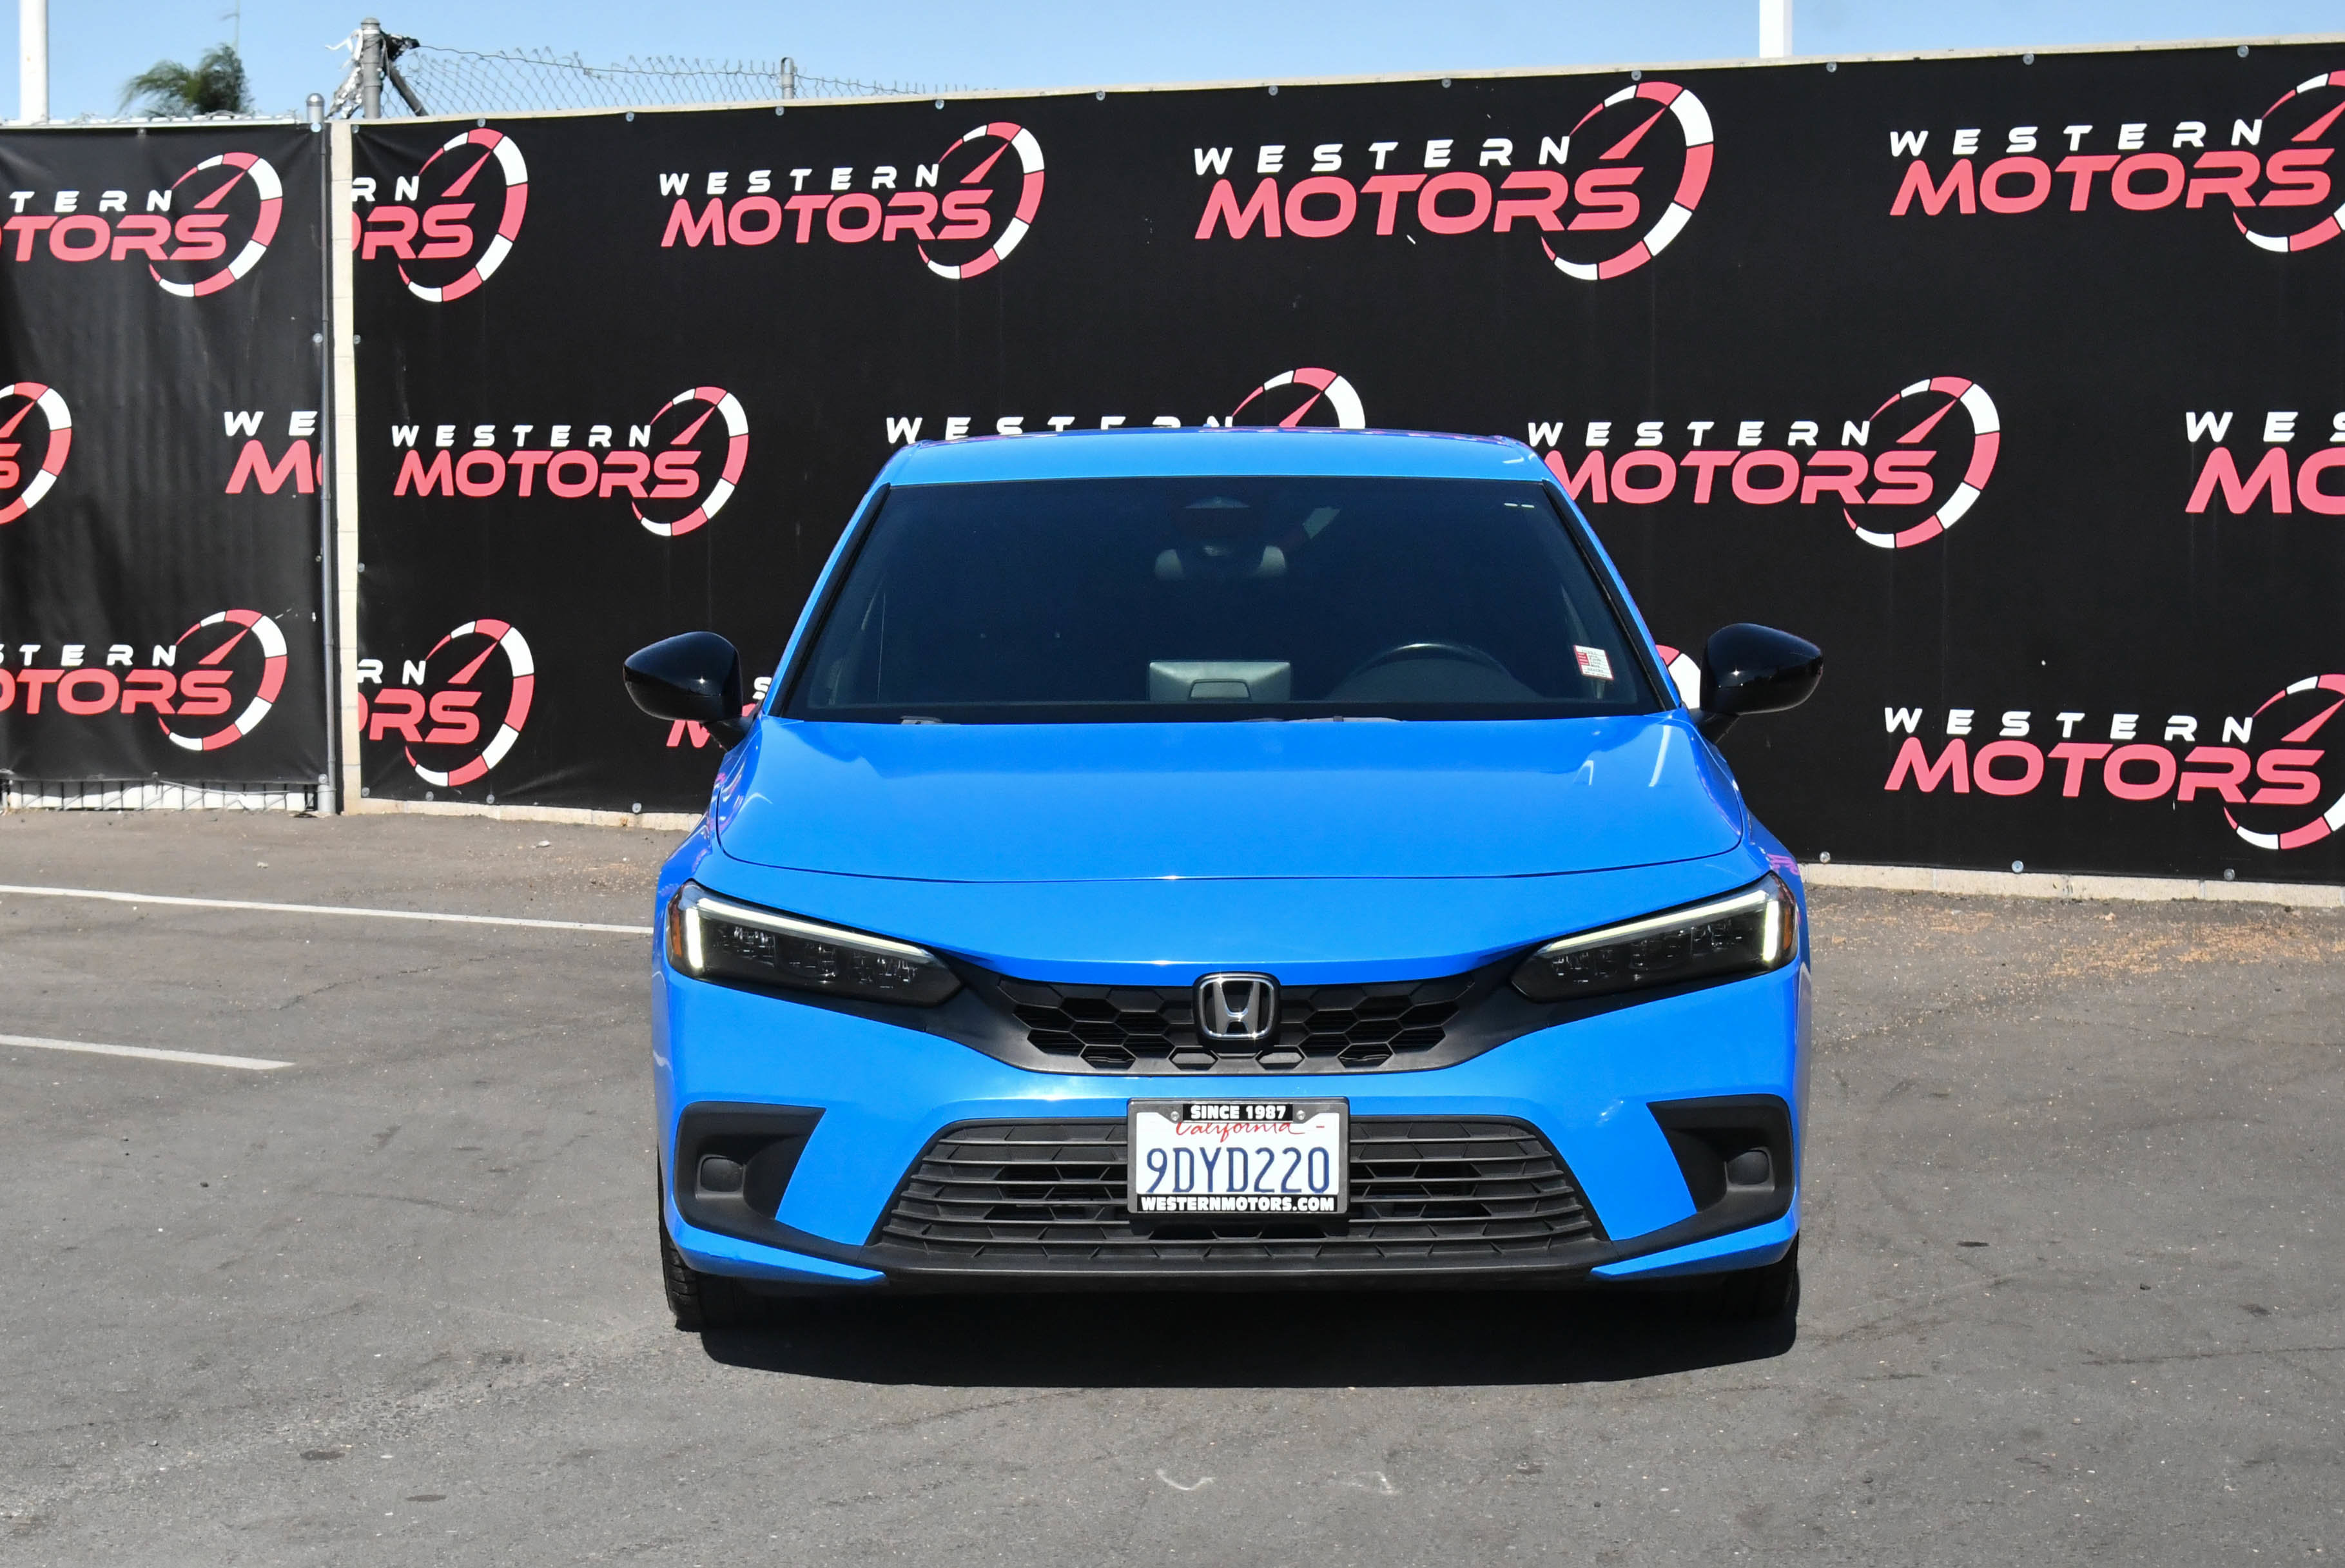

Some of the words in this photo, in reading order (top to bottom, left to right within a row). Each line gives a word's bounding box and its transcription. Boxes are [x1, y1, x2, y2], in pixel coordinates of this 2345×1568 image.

[1194, 135, 1570, 176] WESTERN
[1890, 119, 2262, 157] WESTERN
[659, 163, 939, 197] WESTERN
[1194, 166, 1644, 240] MOTORS
[1889, 148, 2335, 216] MOTORS
[0, 213, 229, 262] TORS
[352, 203, 476, 260] RS
[661, 189, 994, 247] MOTORS
[391, 425, 651, 447] WESTERN
[1527, 420, 1871, 447] WESTERN
[225, 439, 322, 495] M
[393, 449, 702, 498] MOTORS
[1544, 449, 1938, 505] MOTORS
[0, 643, 177, 668] TERN
[357, 688, 483, 745] RS
[1884, 707, 2253, 744] WESTERN
[1884, 737, 2326, 806] MOTORS
[1190, 1105, 1240, 1120] SINCE
[1245, 1105, 1287, 1120] 1987
[1146, 1147, 1330, 1194] 9DYD220
[1141, 1197, 1334, 1212] WESTERNMOTORS.COM
